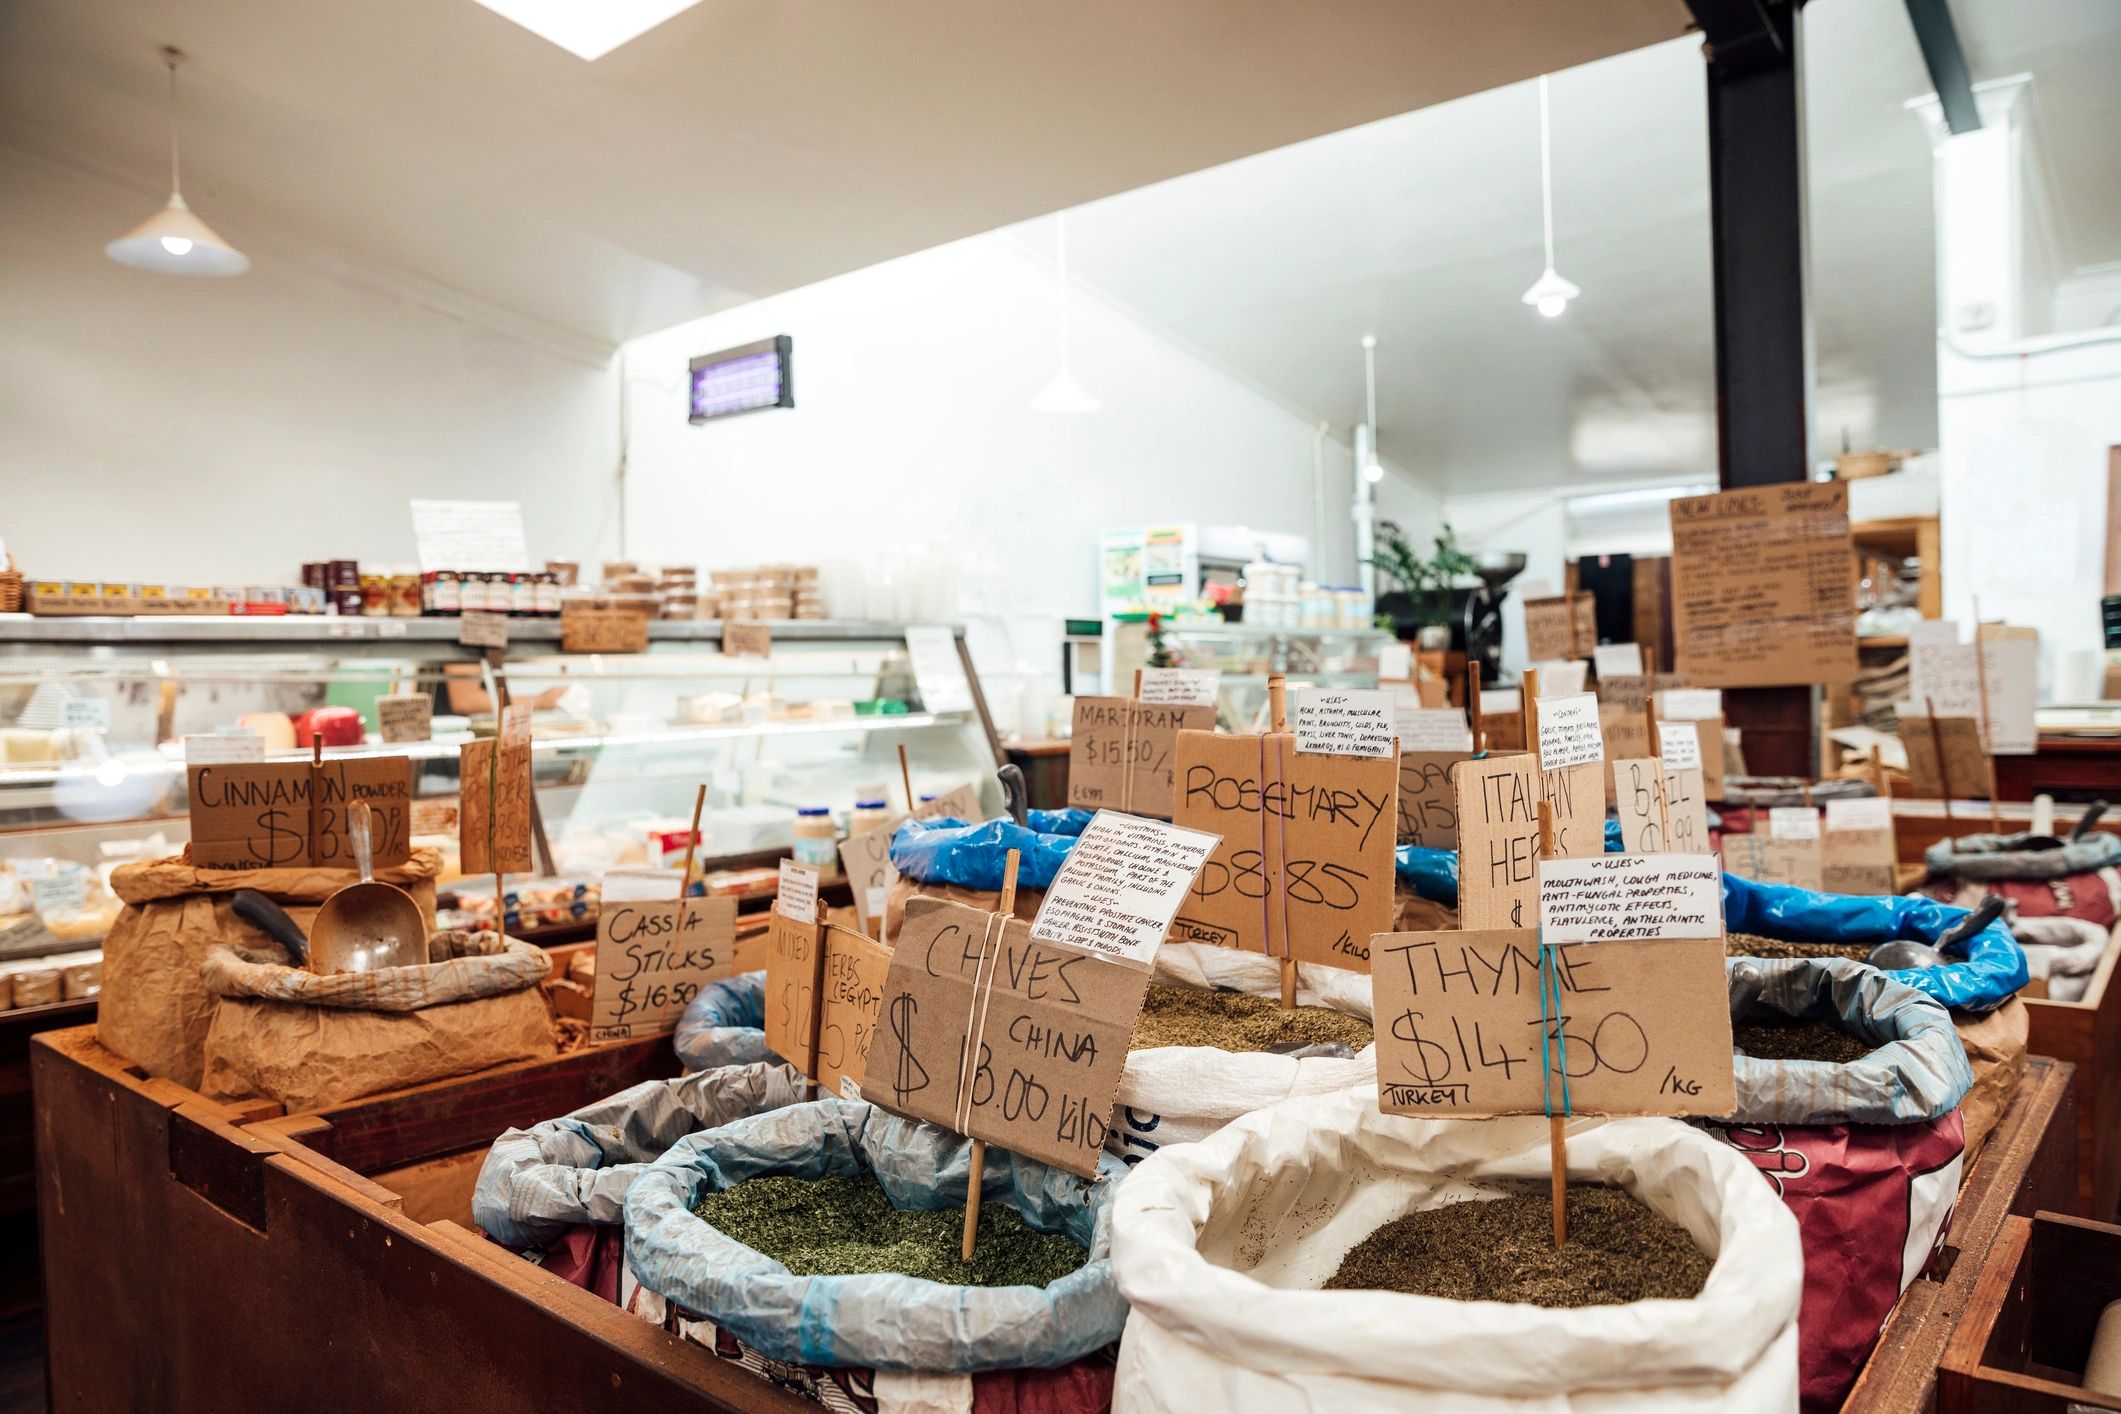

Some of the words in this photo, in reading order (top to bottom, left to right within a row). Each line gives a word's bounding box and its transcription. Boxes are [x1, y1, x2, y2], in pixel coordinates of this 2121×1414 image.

[1360, 734, 1392, 744] DEPRESSION,
[352, 780, 409, 799] POWDER
[1186, 765, 1389, 852] ROSEMARY
[1091, 825, 1110, 835] HIGH
[1143, 844, 1178, 858] VITAMIN
[1128, 862, 1161, 873] CHOLINE
[1060, 876, 1085, 887] GARLIC
[1064, 866, 1092, 878] ALLIUM
[1128, 882, 1167, 896] INCLUDING
[1126, 872, 1148, 882] PART
[1543, 876, 1619, 888] MOUTHWASH,
[1623, 874, 1660, 884] COUGH
[1666, 871, 1717, 881] MEDICINE,
[1625, 886, 1694, 898] PROPERTIES,
[1051, 896, 1097, 912] PREVENTING
[1099, 907, 1136, 922] PROSTATE
[1135, 916, 1163, 932] CANCER,
[1549, 904, 1621, 914] ANTIMYCOTIC
[1625, 900, 1678, 911] EFFECTS,
[609, 909, 703, 943] CASSIA
[1046, 907, 1094, 923] ESOPHAGEAL
[1104, 921, 1138, 934] STOMACH
[1550, 916, 1618, 928] FLATULENCE,
[1623, 914, 1705, 925] ANTHELMINTIC
[1066, 935, 1087, 945] SLEEP
[1590, 926, 1661, 938] PROPERTIES
[1120, 936, 1141, 947] BONE
[777, 926, 809, 962] MIXED
[824, 943, 861, 986] HERBS
[926, 925, 1086, 1004] CHVES
[1384, 941, 1611, 996] THYME
[1008, 1014, 1099, 1068] CHINA
[1391, 1008, 1649, 1087] $14.30
[1659, 1065, 1704, 1095] /KG
[1383, 1086, 1456, 1106] TURKEY
